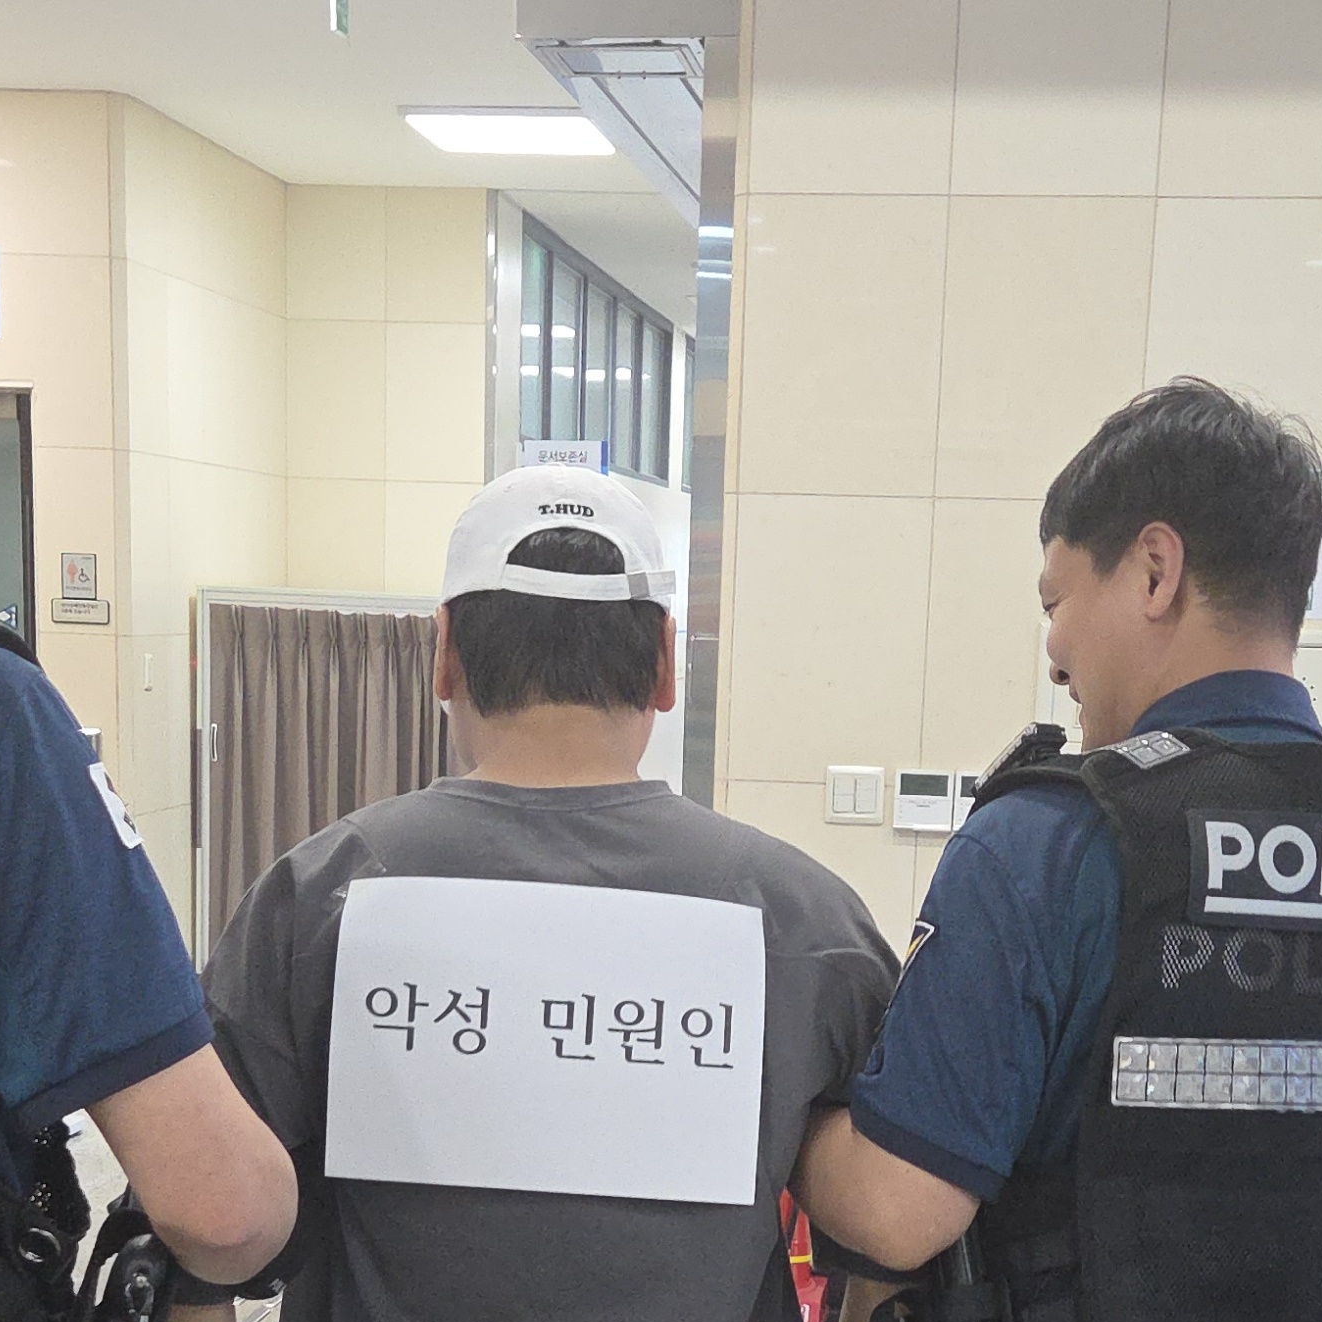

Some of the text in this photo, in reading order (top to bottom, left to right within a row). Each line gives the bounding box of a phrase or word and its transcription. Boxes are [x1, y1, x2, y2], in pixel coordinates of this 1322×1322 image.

[538, 449, 588, 463] 문서보존실
[538, 503, 595, 517] T.HUD
[364, 982, 735, 1070] 악성 민원인
